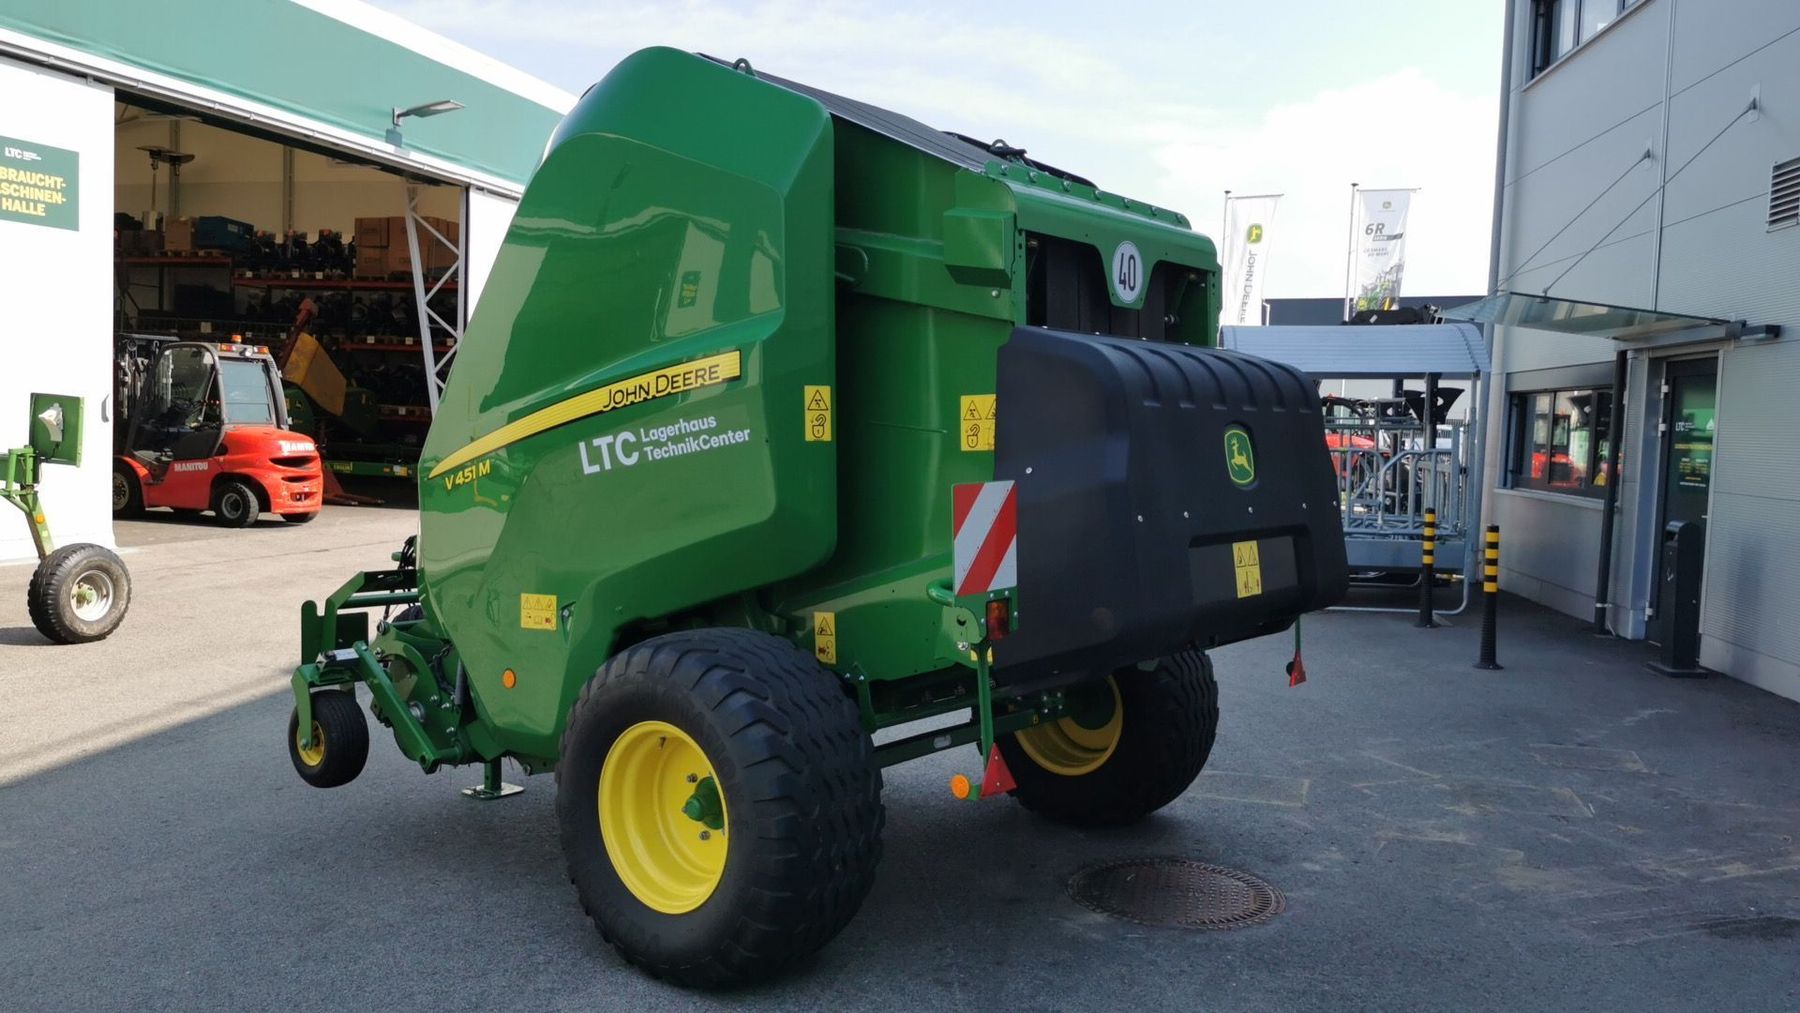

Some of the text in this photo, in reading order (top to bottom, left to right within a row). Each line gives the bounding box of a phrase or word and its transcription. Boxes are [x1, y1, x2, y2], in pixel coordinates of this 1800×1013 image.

[5, 147, 22, 159] LTC
[2, 197, 46, 216] HALLE
[1365, 223, 1385, 235] 6R
[1118, 252, 1136, 291] 40
[1245, 250, 1257, 282] JOHN
[603, 364, 720, 410] JOHN DEERE
[1675, 422, 1685, 432] LTC
[578, 415, 717, 475] LTC Lagerhaus
[642, 427, 751, 461] TechnikCenter
[174, 462, 209, 473] MANITOU
[445, 459, 491, 491] V 451 M
